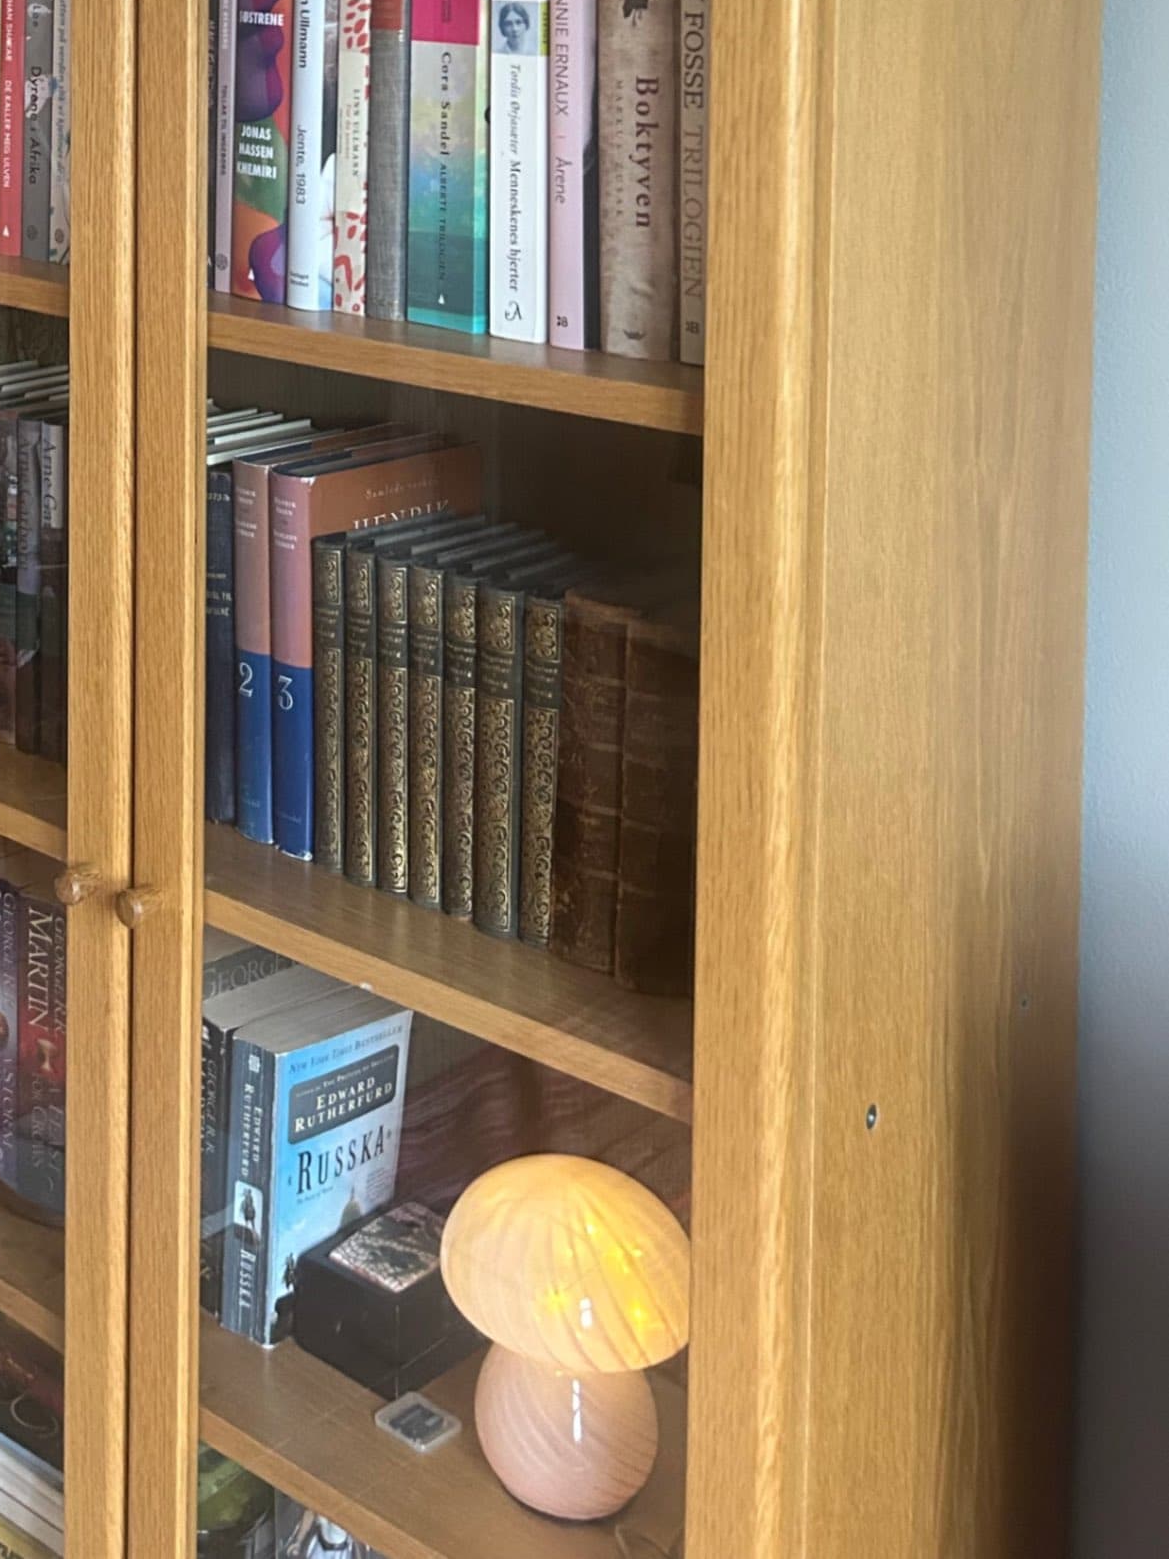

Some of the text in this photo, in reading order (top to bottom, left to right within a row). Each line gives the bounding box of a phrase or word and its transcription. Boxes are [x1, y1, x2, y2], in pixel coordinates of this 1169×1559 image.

[5, 24, 14, 62] SHAKAR
[298, 10, 311, 68] Ullmann
[683, 11, 705, 110] FOSSE
[4, 80, 13, 92] DE
[555, 44, 569, 116] ERNAUX
[4, 96, 13, 130] KALLER
[241, 125, 272, 140] JONAS
[352, 89, 360, 177] LINN ULLMANN
[438, 52, 451, 213] Cora Sandel ALBERTE
[3, 133, 12, 155] MEG
[29, 140, 40, 185] Afrika
[237, 161, 277, 180] KHEMIRI
[239, 143, 274, 160] HASSEN
[295, 125, 308, 204] Jente, 1983
[627, 75, 660, 228] Boktyven
[3, 158, 12, 188] ULVEN
[508, 64, 521, 292] Tordis Menneskenes hjerter
[555, 157, 572, 204] Årene
[682, 126, 704, 299] TRILOGIEN
[43, 439, 57, 488] Arne
[238, 662, 254, 697] 2
[278, 675, 294, 711] 3
[3, 892, 15, 966] GEORGE
[54, 917, 66, 993] GEORGE
[28, 906, 53, 1034] MARTIN
[289, 1061, 307, 1075] NEW
[316, 1076, 376, 1111] EDWARD
[240, 1082, 255, 1178] RUTHERFURD
[251, 1105, 263, 1163] EDWARD
[294, 1082, 393, 1133] RUTHERFURD
[297, 1124, 385, 1194] RUSSKA
[238, 1249, 256, 1310] RUSSKA
